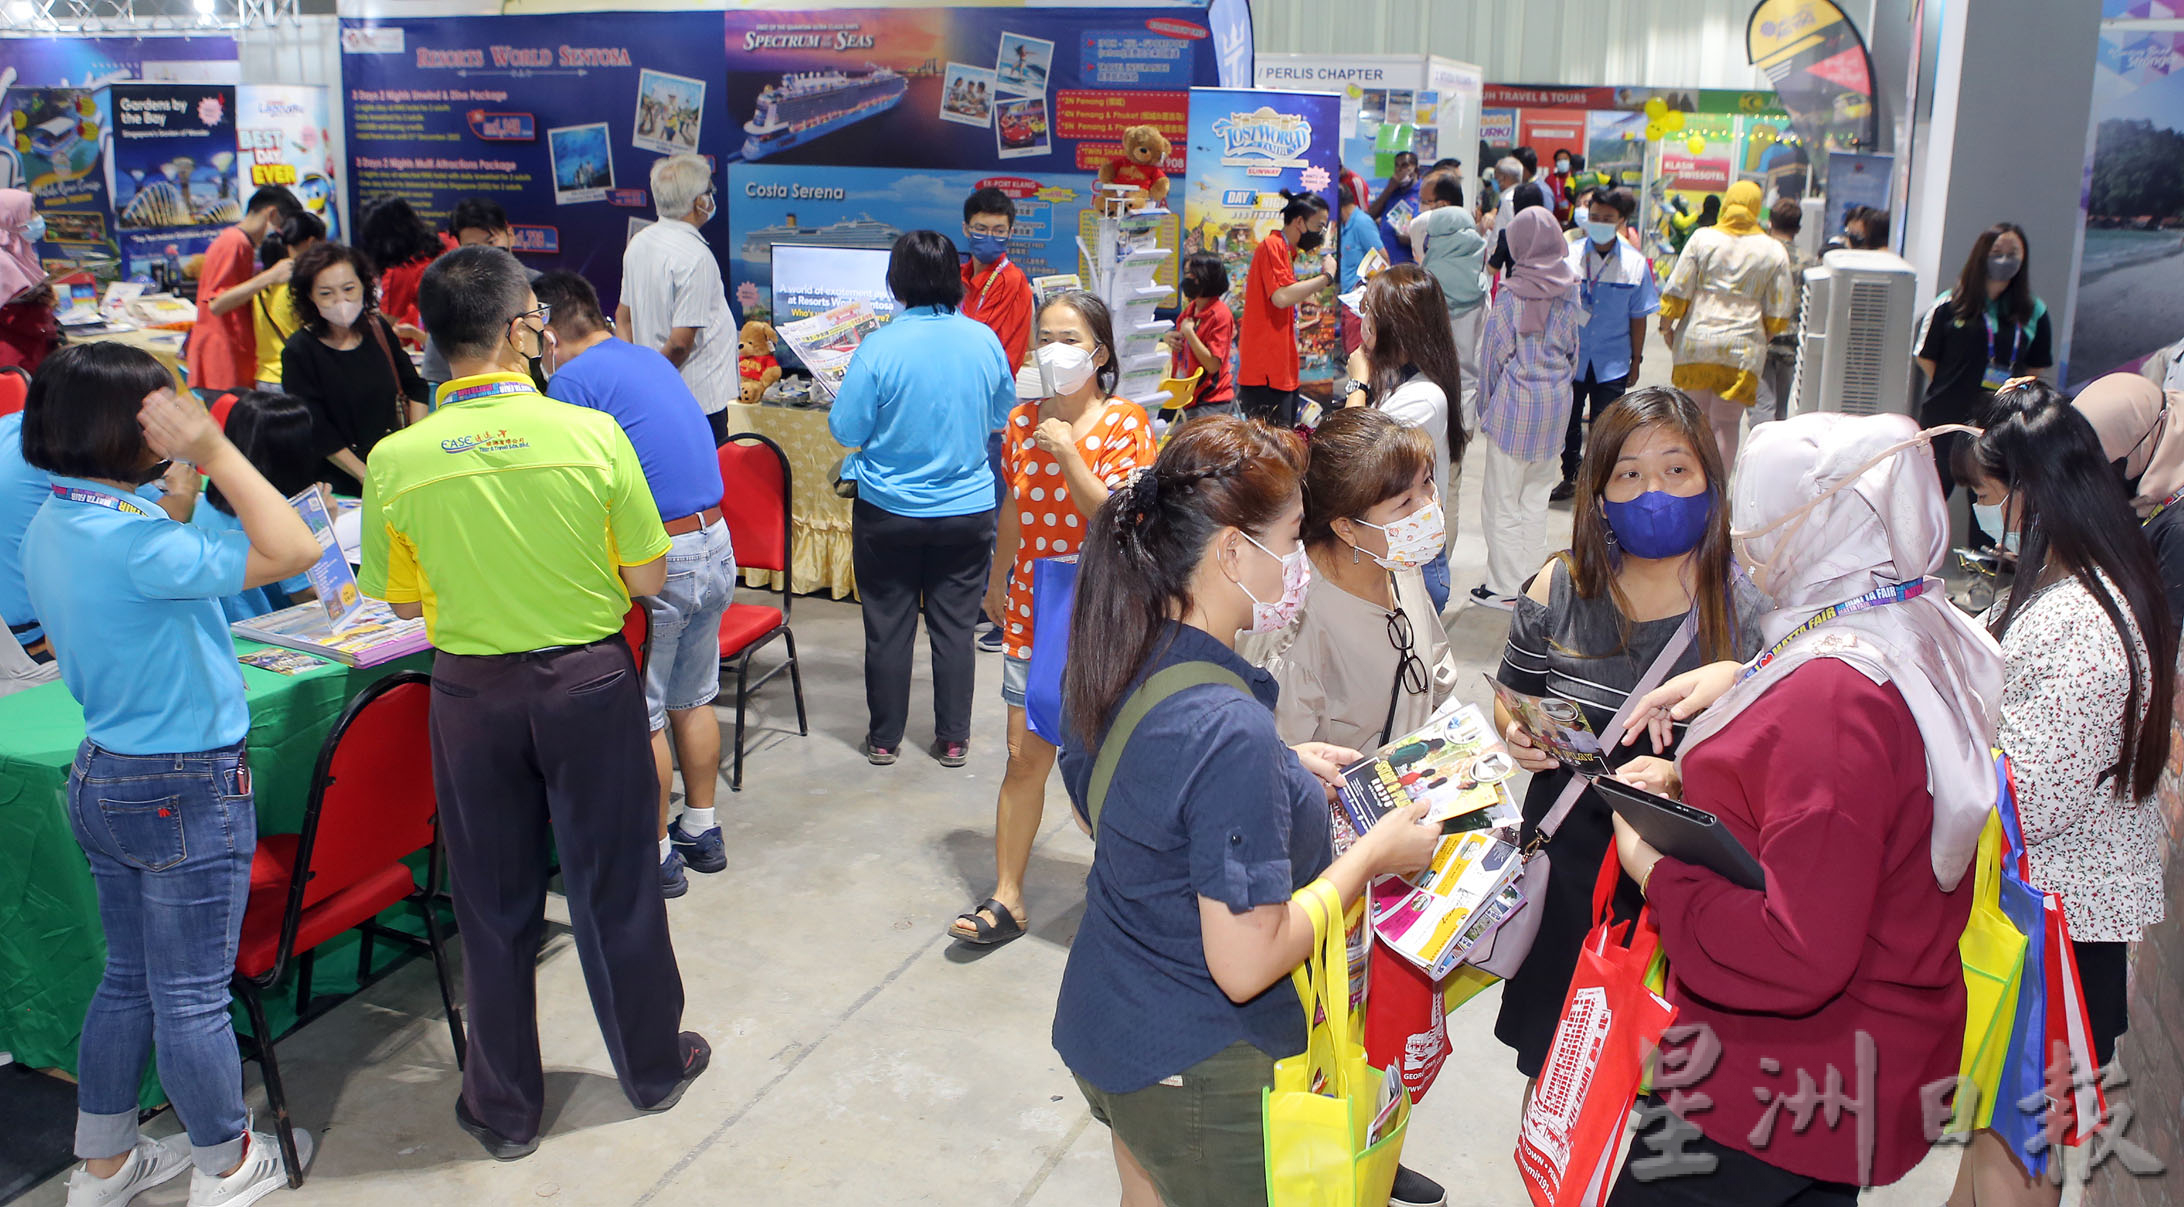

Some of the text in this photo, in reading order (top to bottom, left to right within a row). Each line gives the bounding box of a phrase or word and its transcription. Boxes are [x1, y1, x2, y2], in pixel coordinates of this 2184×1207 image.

[743, 31, 821, 50] SPECTRUM
[834, 31, 874, 50] SEAS
[416, 45, 632, 67] RESORTS WORLD SENTOSA
[1266, 68, 1313, 79] PERLIS
[1317, 68, 1384, 80] CHAPTER
[1077, 98, 1104, 107] Penang
[1500, 92, 1537, 102] TRAVEL
[1551, 93, 1587, 103] TOURS
[120, 97, 171, 112] Gardens
[171, 98, 187, 115] by
[120, 112, 166, 127] the Bay
[1076, 111, 1104, 120] Penang
[1078, 123, 1106, 132] Penang
[238, 130, 282, 150] BEST
[1257, 124, 1307, 150] WORLD
[1664, 160, 1696, 170] KLASIK
[252, 165, 297, 185] EVER
[1679, 170, 1727, 182] SWISSOTEL
[745, 182, 845, 200] Costa Serena
[1227, 191, 1250, 204] DAY
[780, 284, 787, 294] A
[788, 284, 813, 295] world
[815, 285, 824, 295] of
[825, 287, 872, 297] excitement
[788, 296, 797, 305] at
[798, 296, 830, 306] Resorts
[791, 308, 815, 318] Who's
[71, 492, 112, 508] MATTA FAIR
[1876, 585, 1897, 600] FAIR
[1771, 623, 1807, 656] MATTA
[1808, 605, 1838, 631] FAIR
[1375, 760, 1398, 784] STAY
